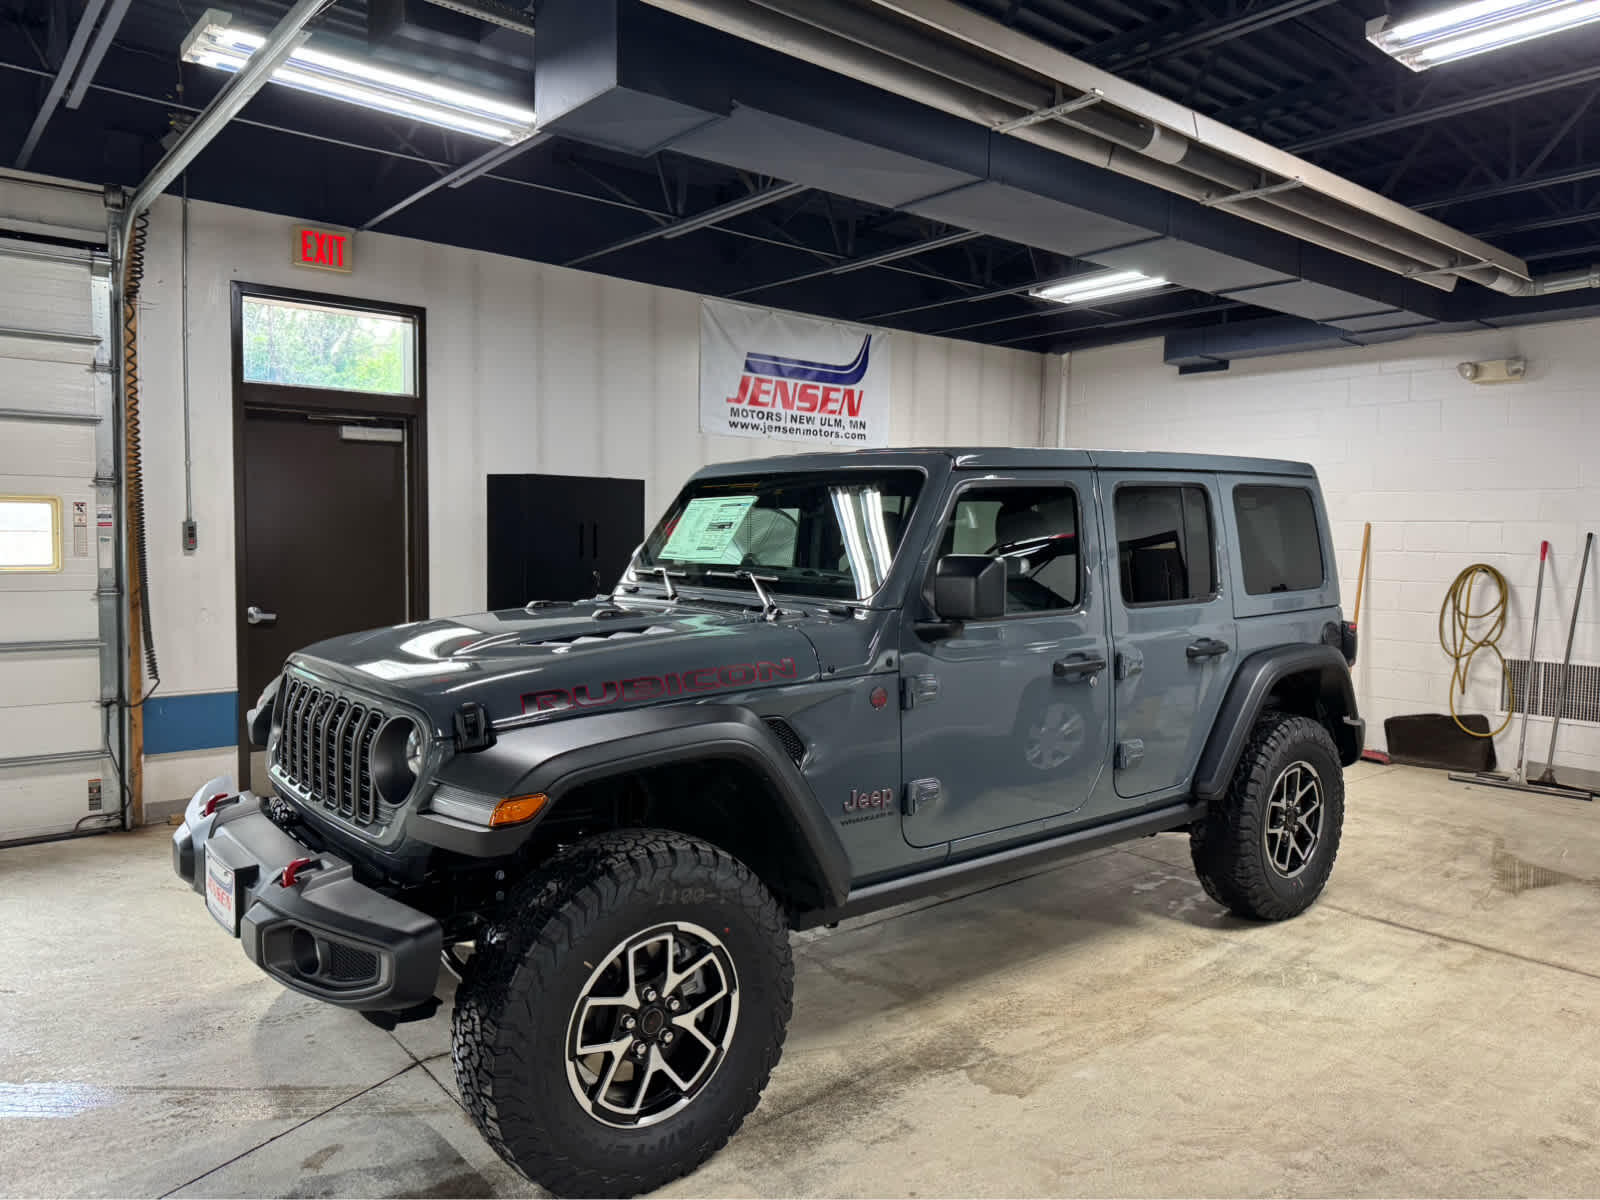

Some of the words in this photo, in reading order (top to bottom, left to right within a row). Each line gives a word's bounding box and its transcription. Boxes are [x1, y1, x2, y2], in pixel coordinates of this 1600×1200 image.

[301, 230, 347, 267] EXIT
[726, 375, 863, 417] JENSEN
[728, 420, 866, 440] www.jensenmotors.com
[730, 407, 782, 422] MOTORS
[790, 414, 815, 425] NEW
[820, 416, 845, 430] ULM,
[849, 419, 866, 430] MN
[520, 657, 797, 715] RUBICON
[843, 788, 893, 813] Jeep
